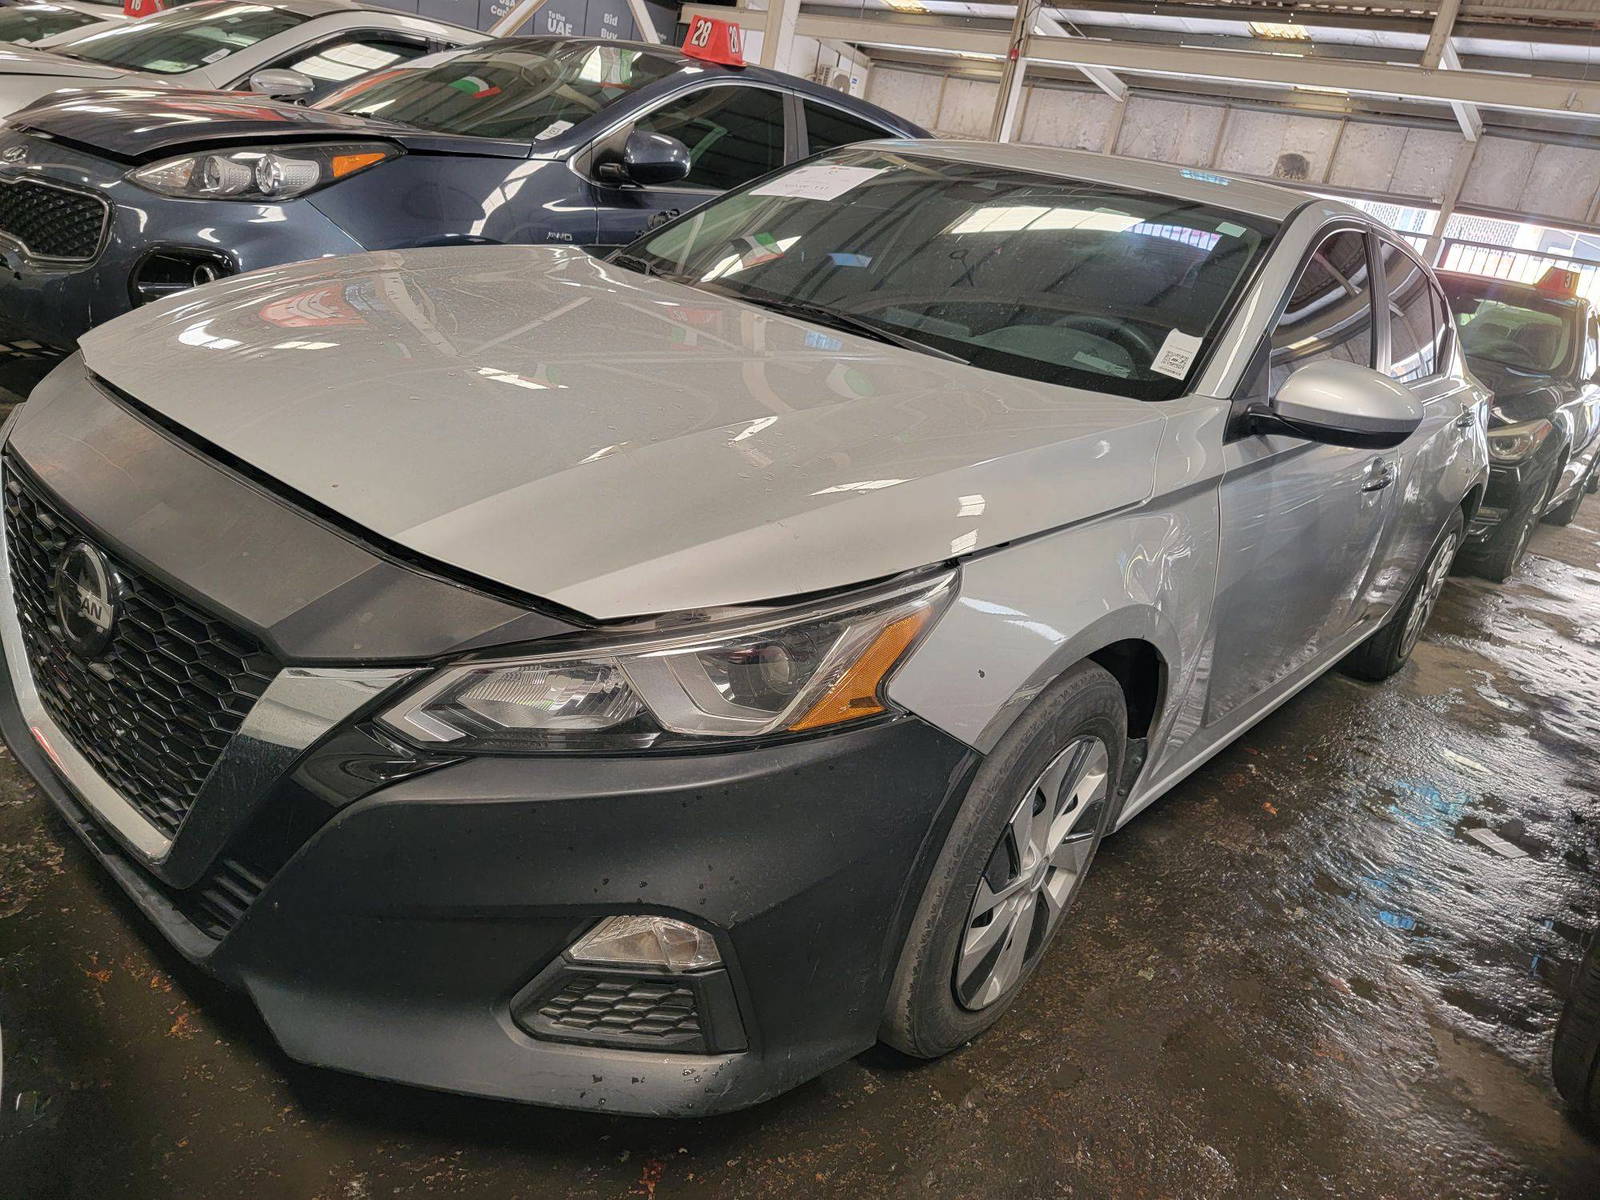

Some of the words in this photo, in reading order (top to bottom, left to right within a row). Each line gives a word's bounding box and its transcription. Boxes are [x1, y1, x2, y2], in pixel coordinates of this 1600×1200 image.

[547, 17, 573, 37] UAE
[603, 13, 618, 26] Bid
[690, 19, 713, 48] 28
